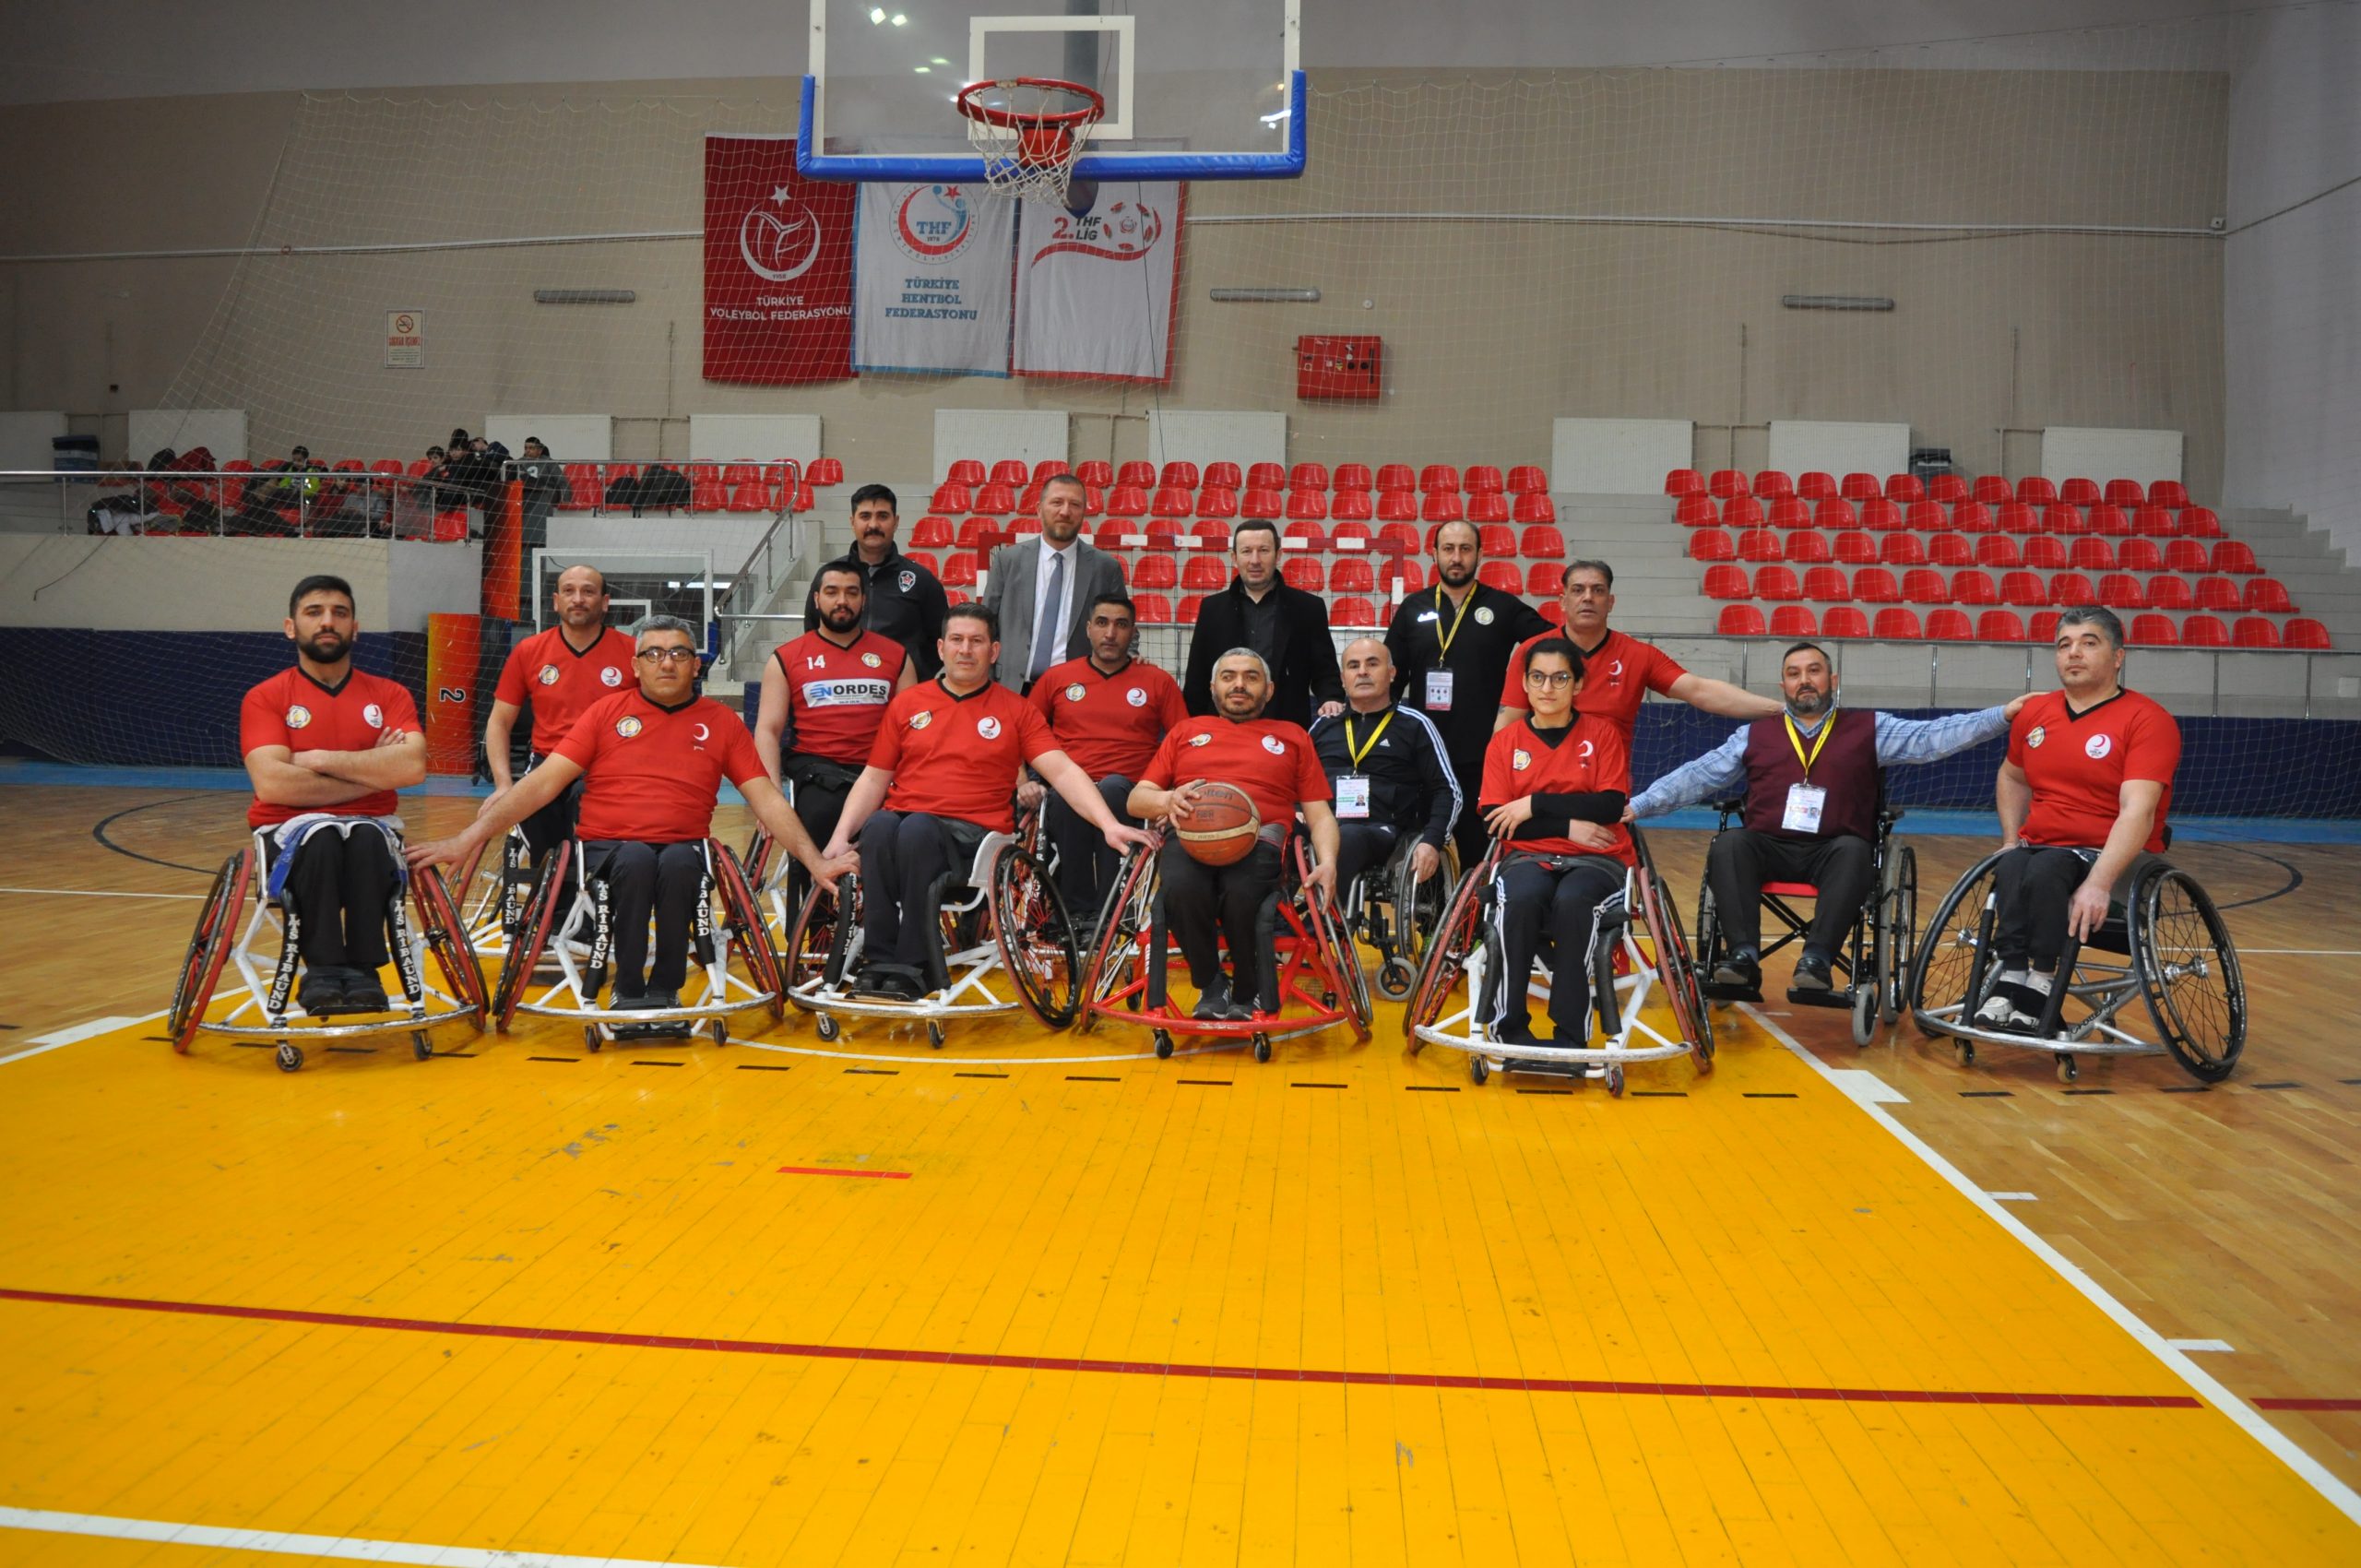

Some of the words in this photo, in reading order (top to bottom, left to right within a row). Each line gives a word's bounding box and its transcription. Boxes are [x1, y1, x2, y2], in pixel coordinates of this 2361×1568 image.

[916, 221, 952, 234] THF
[1075, 216, 1102, 227] THF
[905, 277, 959, 290] TÜRKİYE
[756, 294, 804, 306] TÜRKİYE
[901, 293, 962, 304] HENTBOL
[710, 307, 766, 321] VOLEYBOL
[770, 305, 852, 321] FEDERASYONU
[884, 307, 978, 320] FEDERASYONU
[807, 655, 825, 670] 14
